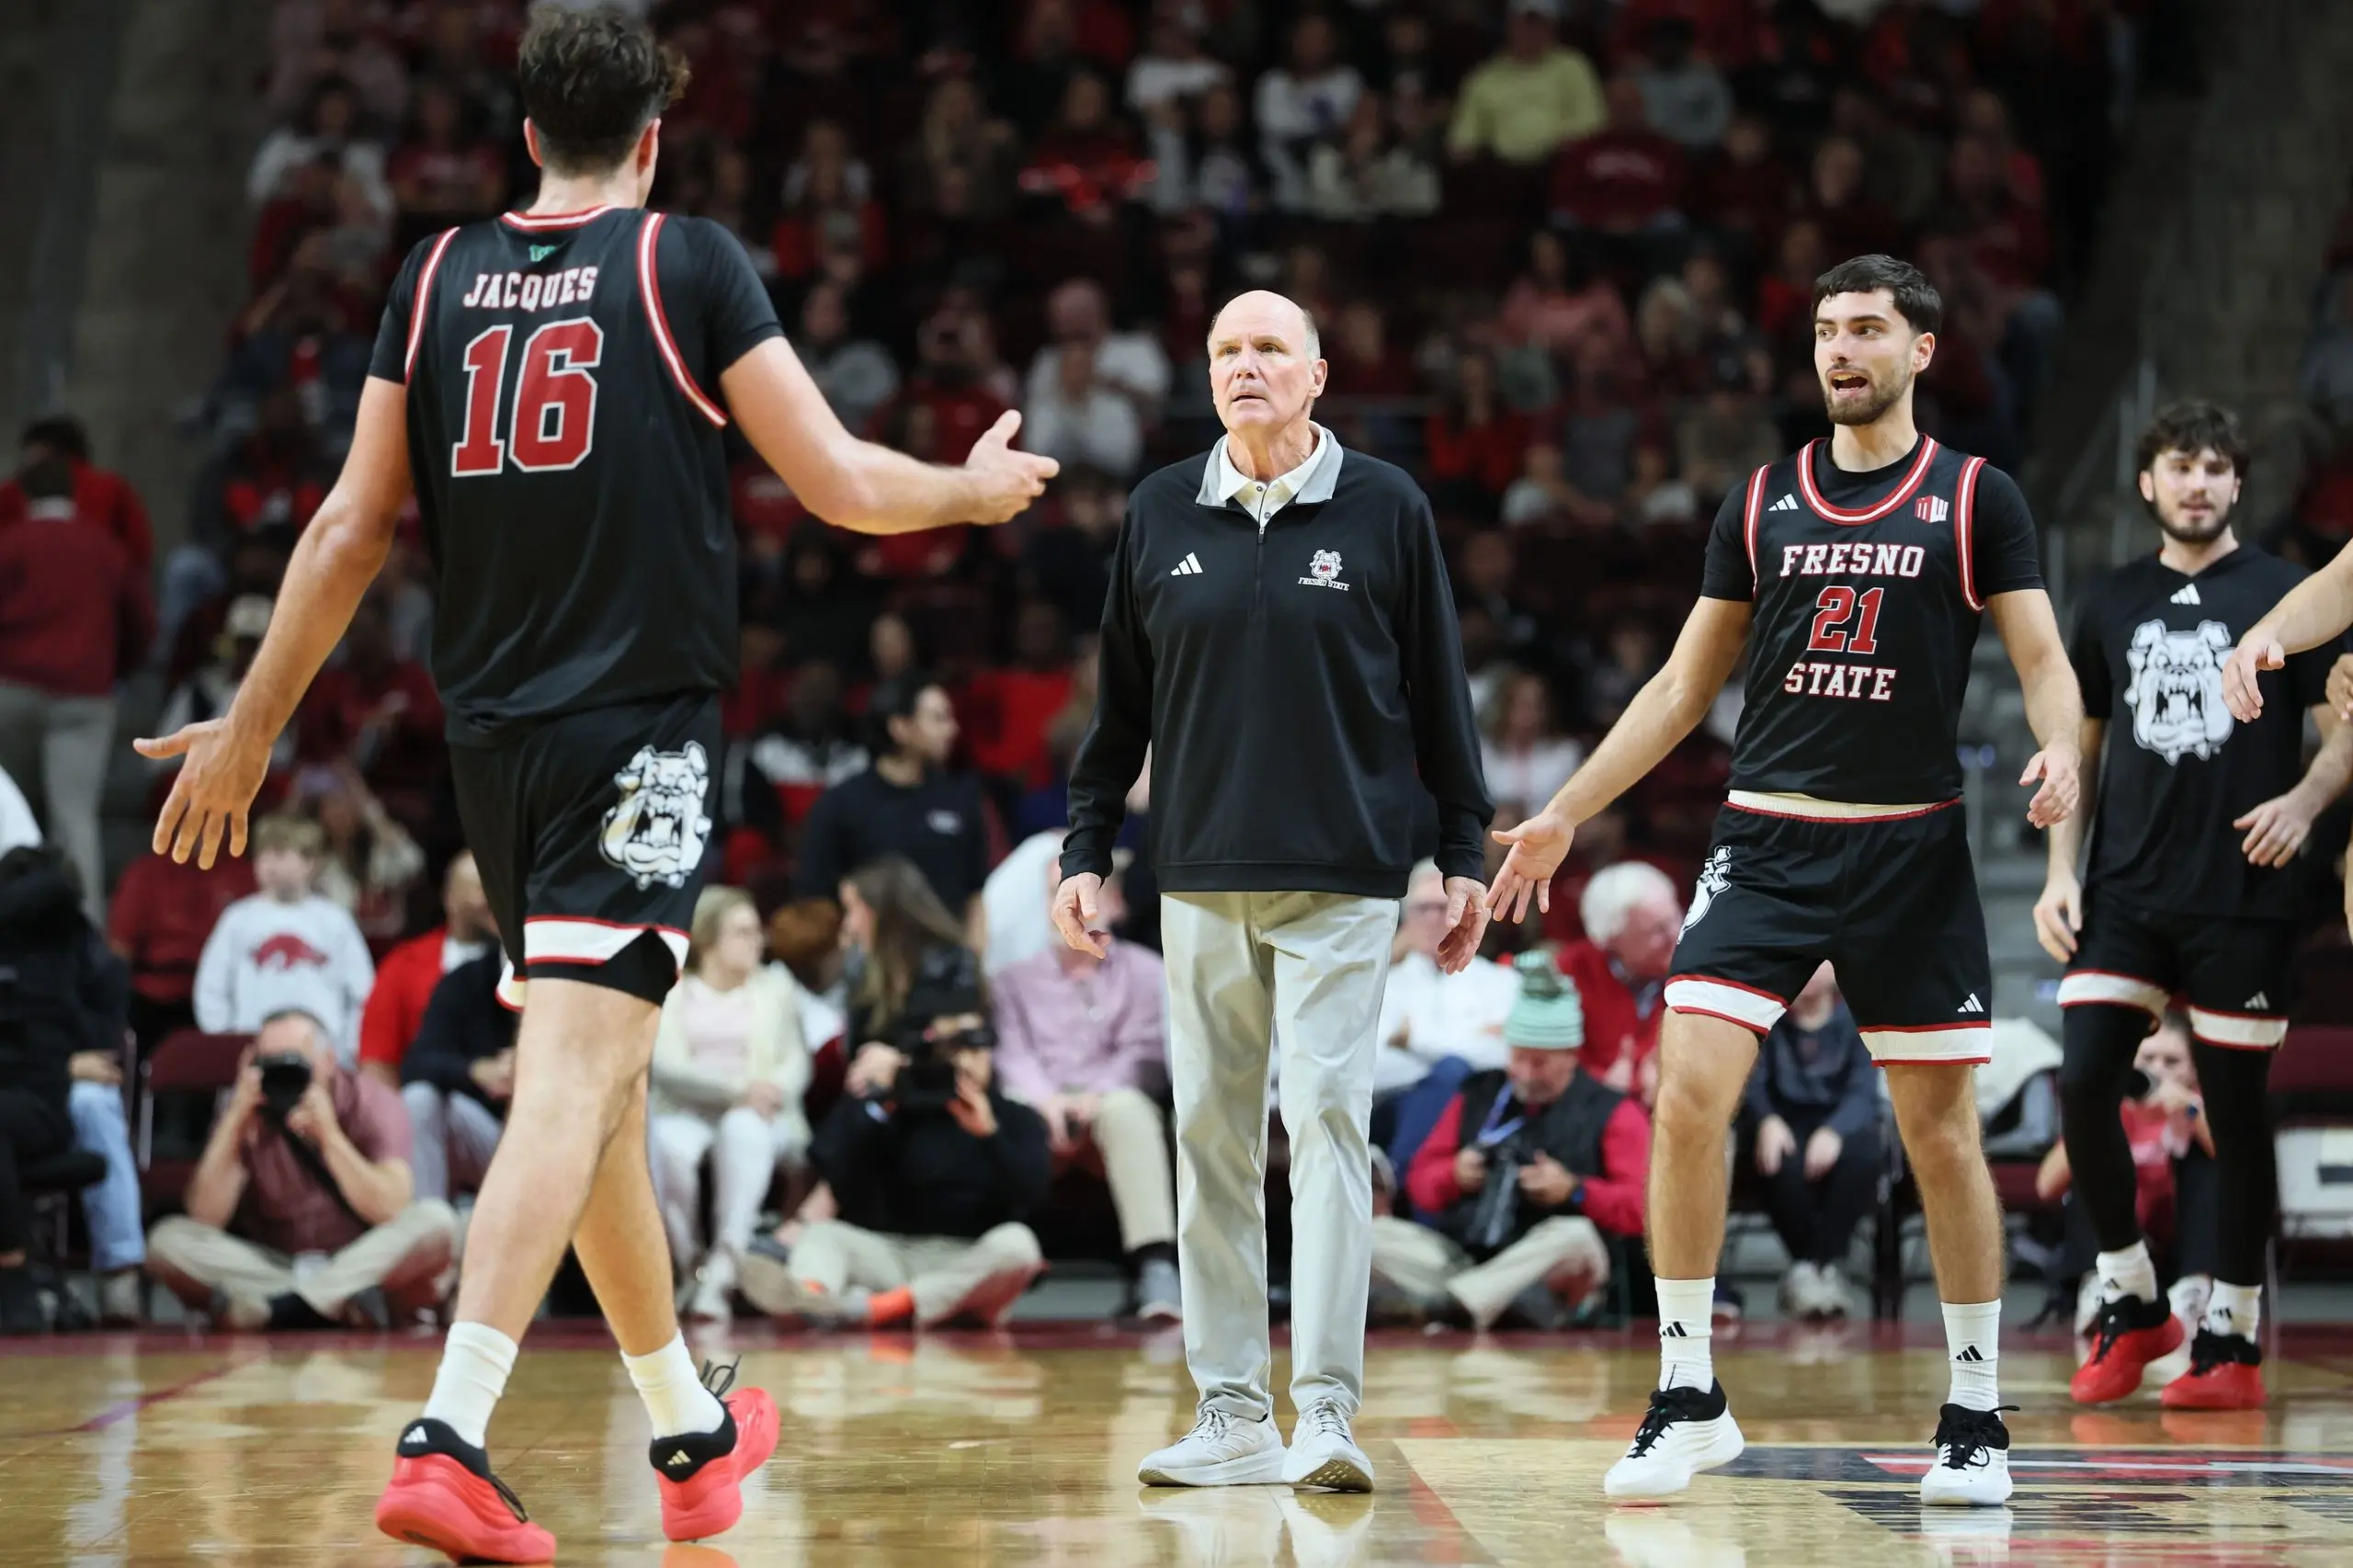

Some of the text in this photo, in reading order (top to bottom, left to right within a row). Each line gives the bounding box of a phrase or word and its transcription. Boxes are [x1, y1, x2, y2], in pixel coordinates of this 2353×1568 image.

[462, 266, 599, 312] JACQUES
[451, 316, 604, 477] 16
[1779, 542, 1926, 578] FRESNO
[1298, 576, 1350, 592] FRESNO STATE
[1806, 585, 1884, 654] 21
[1784, 662, 1896, 701] STATE
